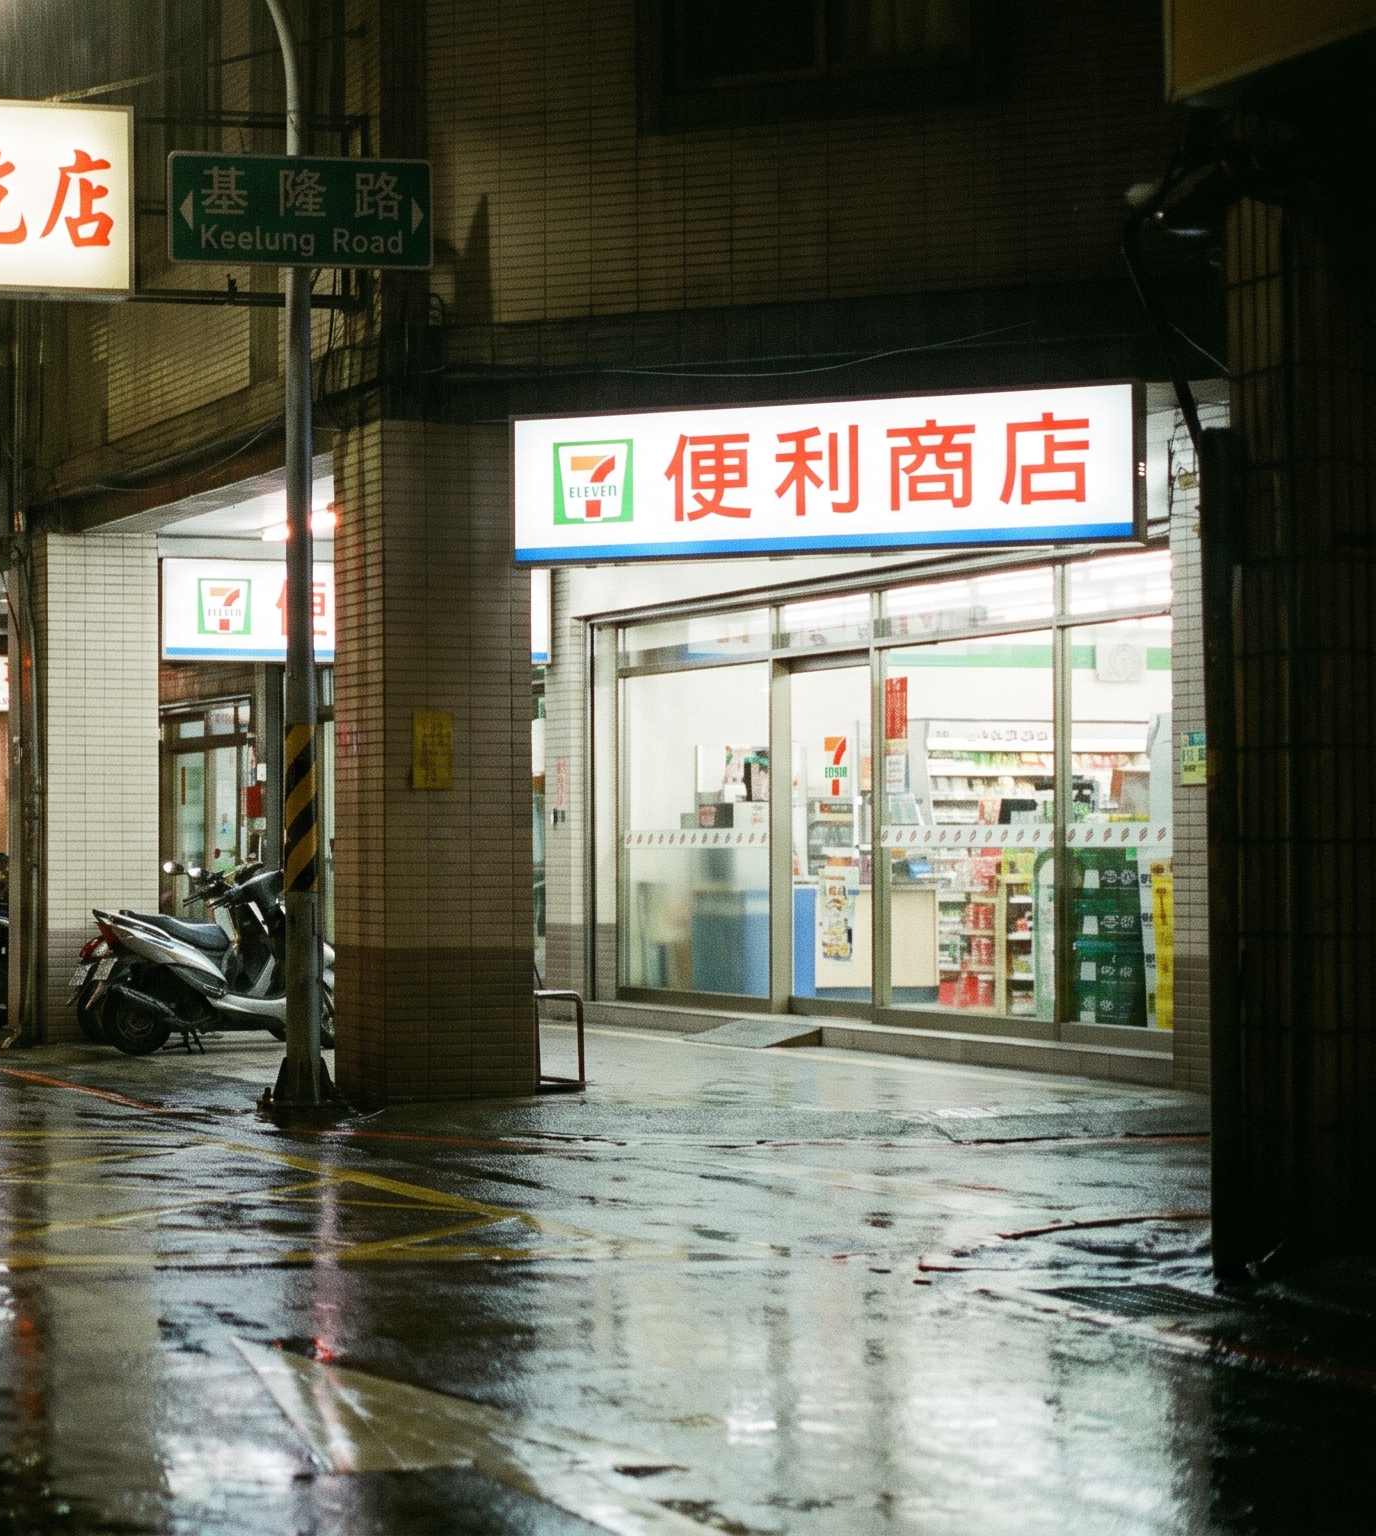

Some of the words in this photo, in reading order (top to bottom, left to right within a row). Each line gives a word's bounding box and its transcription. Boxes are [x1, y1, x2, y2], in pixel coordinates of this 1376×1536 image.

[200, 165, 403, 220] 基隆路
[200, 224, 315, 256] Keelung
[333, 227, 403, 254] Road
[663, 411, 1090, 522] 便利商店
